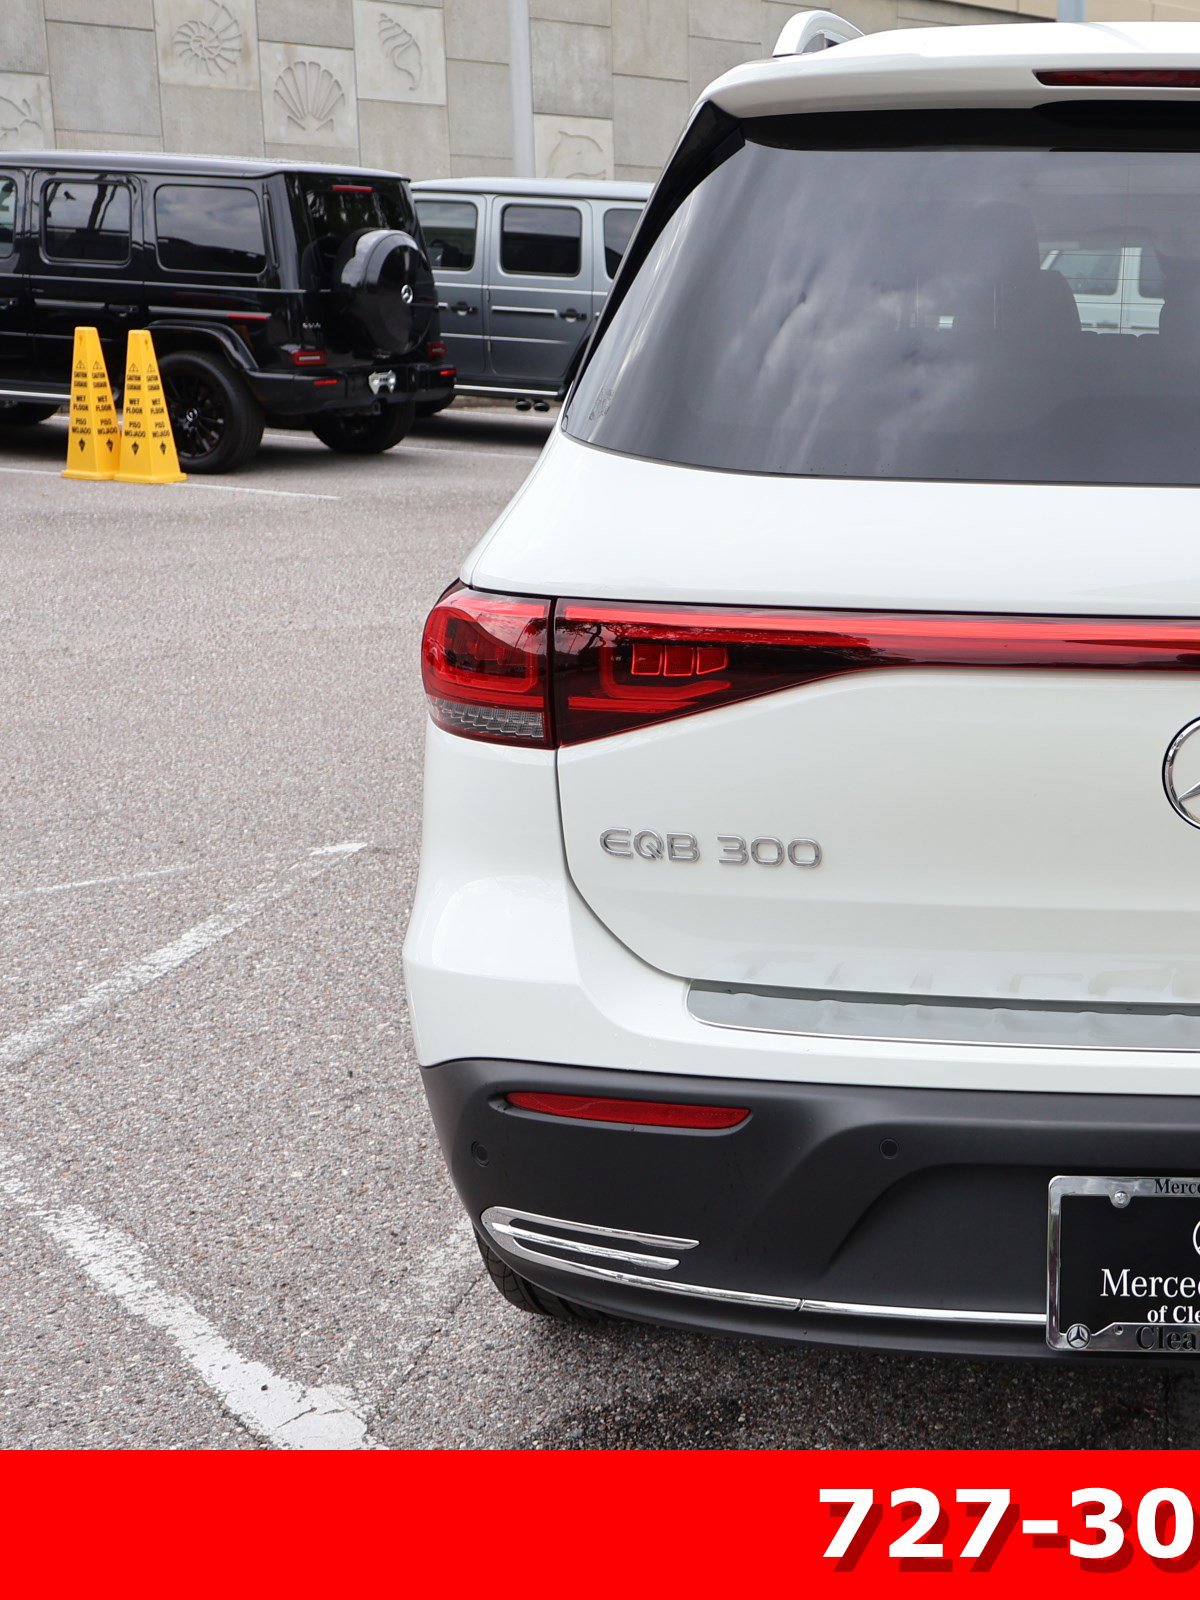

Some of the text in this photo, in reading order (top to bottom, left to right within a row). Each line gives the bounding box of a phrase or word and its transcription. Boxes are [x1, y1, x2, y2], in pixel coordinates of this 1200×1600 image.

[96, 404, 112, 412] FLOOR
[126, 407, 143, 415] FLOOR
[599, 827, 823, 868] EQB 300
[1147, 1305, 1168, 1323] of
